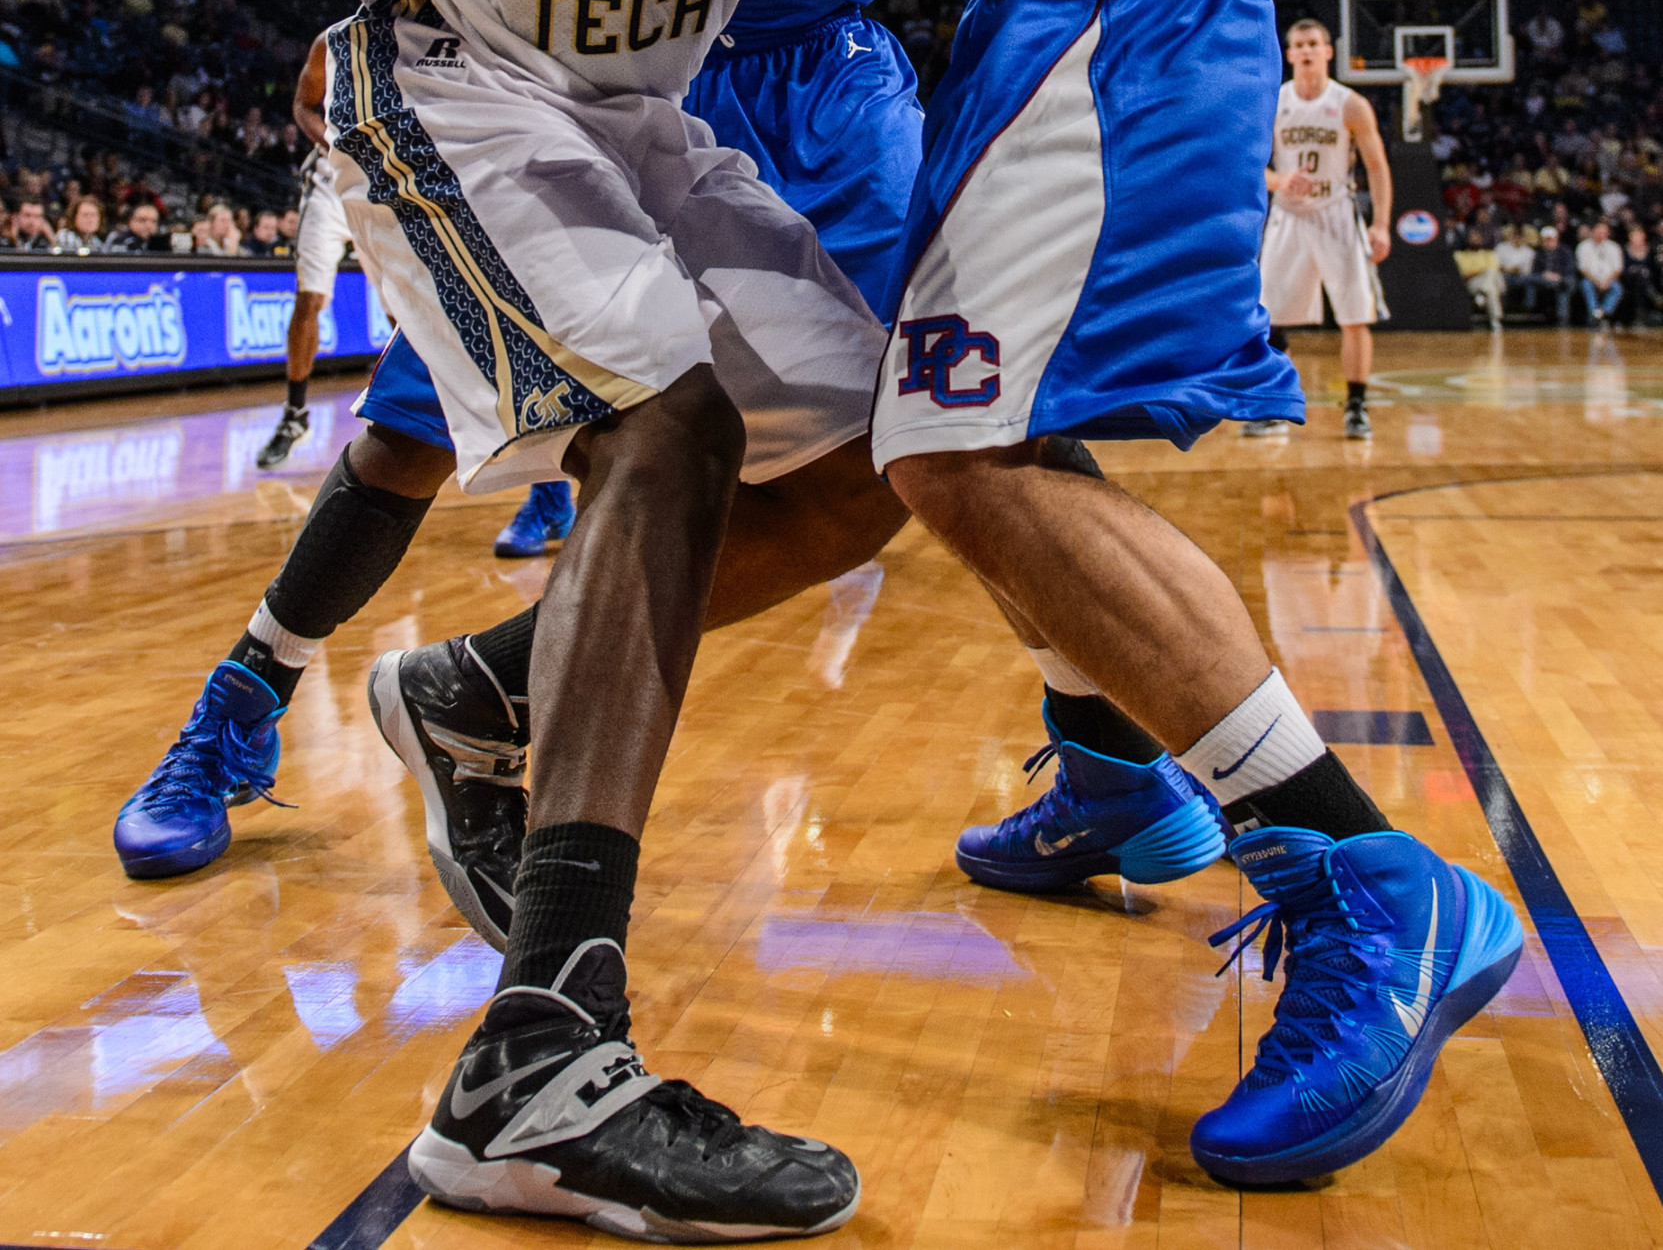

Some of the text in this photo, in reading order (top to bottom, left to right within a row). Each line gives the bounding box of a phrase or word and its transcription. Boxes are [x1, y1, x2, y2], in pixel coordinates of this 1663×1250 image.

[415, 59, 467, 69] RUSSELL
[1281, 125, 1338, 147] GEORGIA
[1298, 151, 1319, 175] 10
[38, 277, 188, 374] Aaron's
